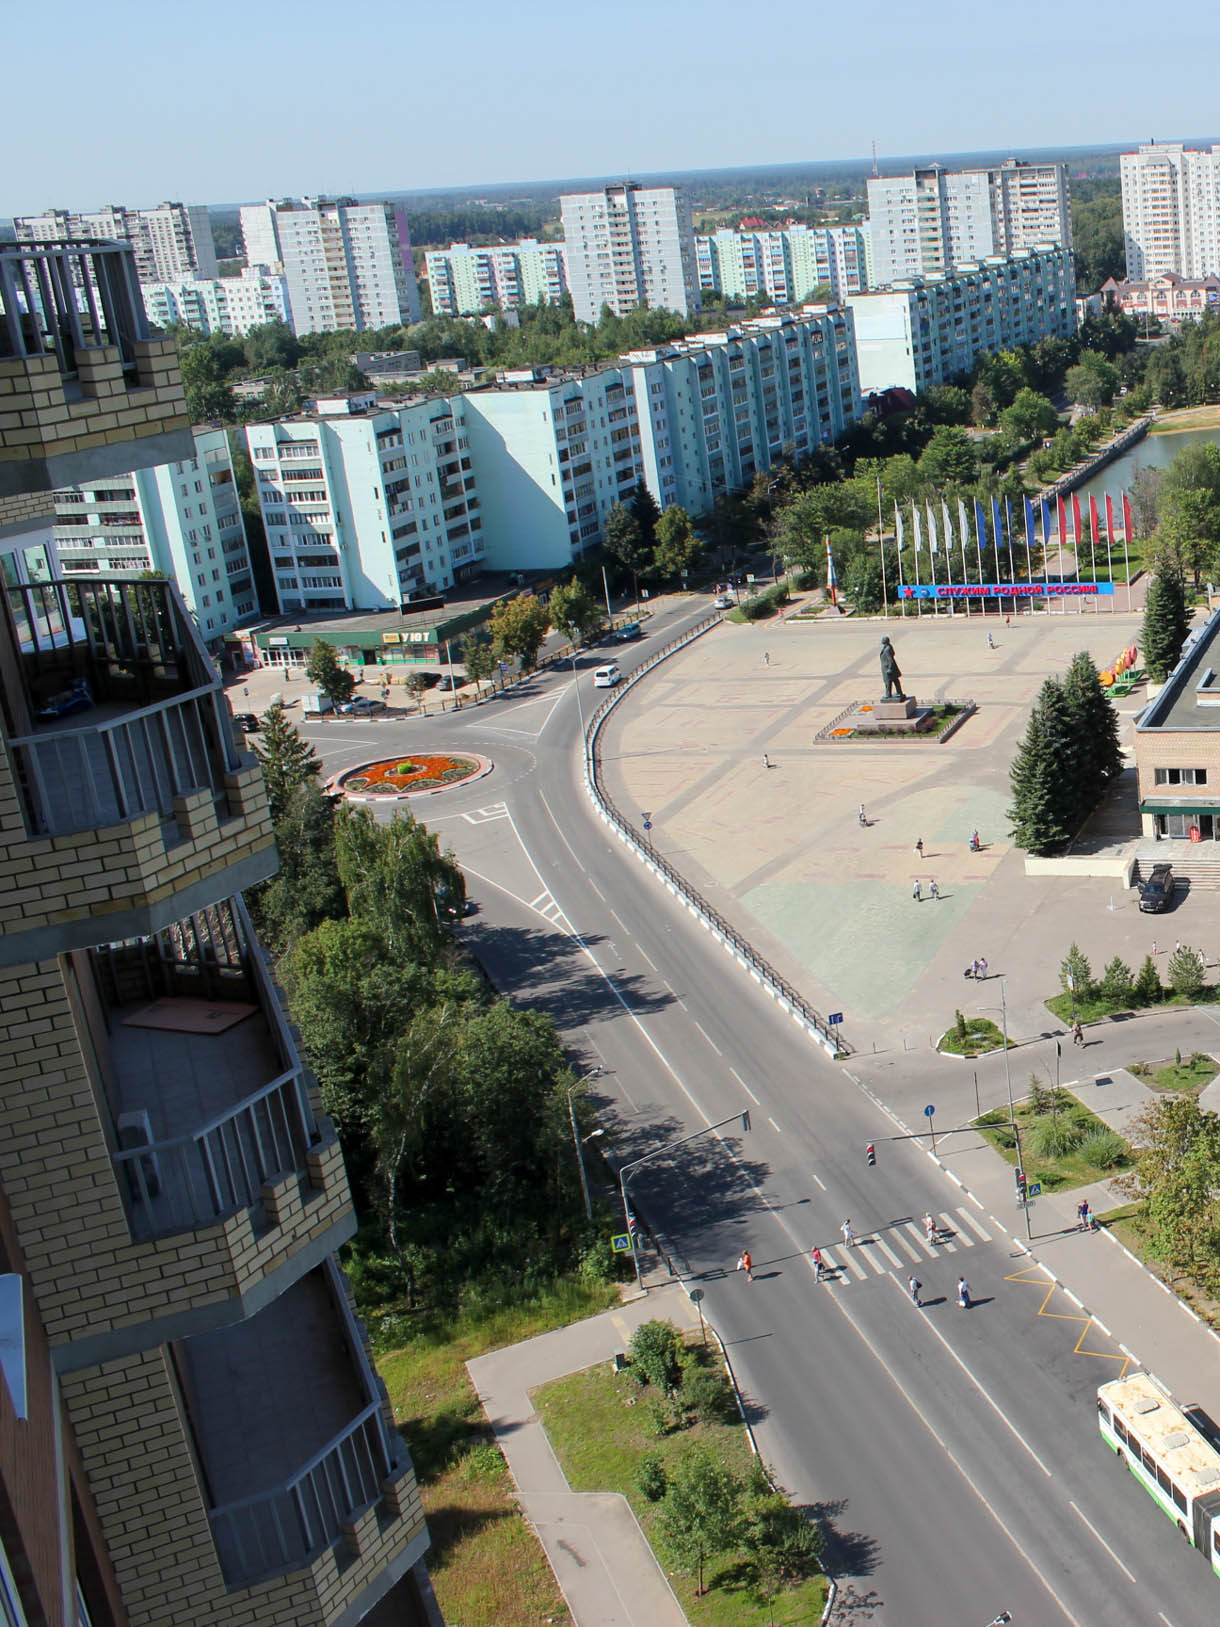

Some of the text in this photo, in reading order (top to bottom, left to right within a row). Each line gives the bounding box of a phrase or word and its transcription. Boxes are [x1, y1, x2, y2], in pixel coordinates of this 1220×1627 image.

[937, 587, 990, 596] СЛУЖИМ
[993, 584, 1043, 595] РОДНОЙ
[401, 632, 429, 642] УЮТ
